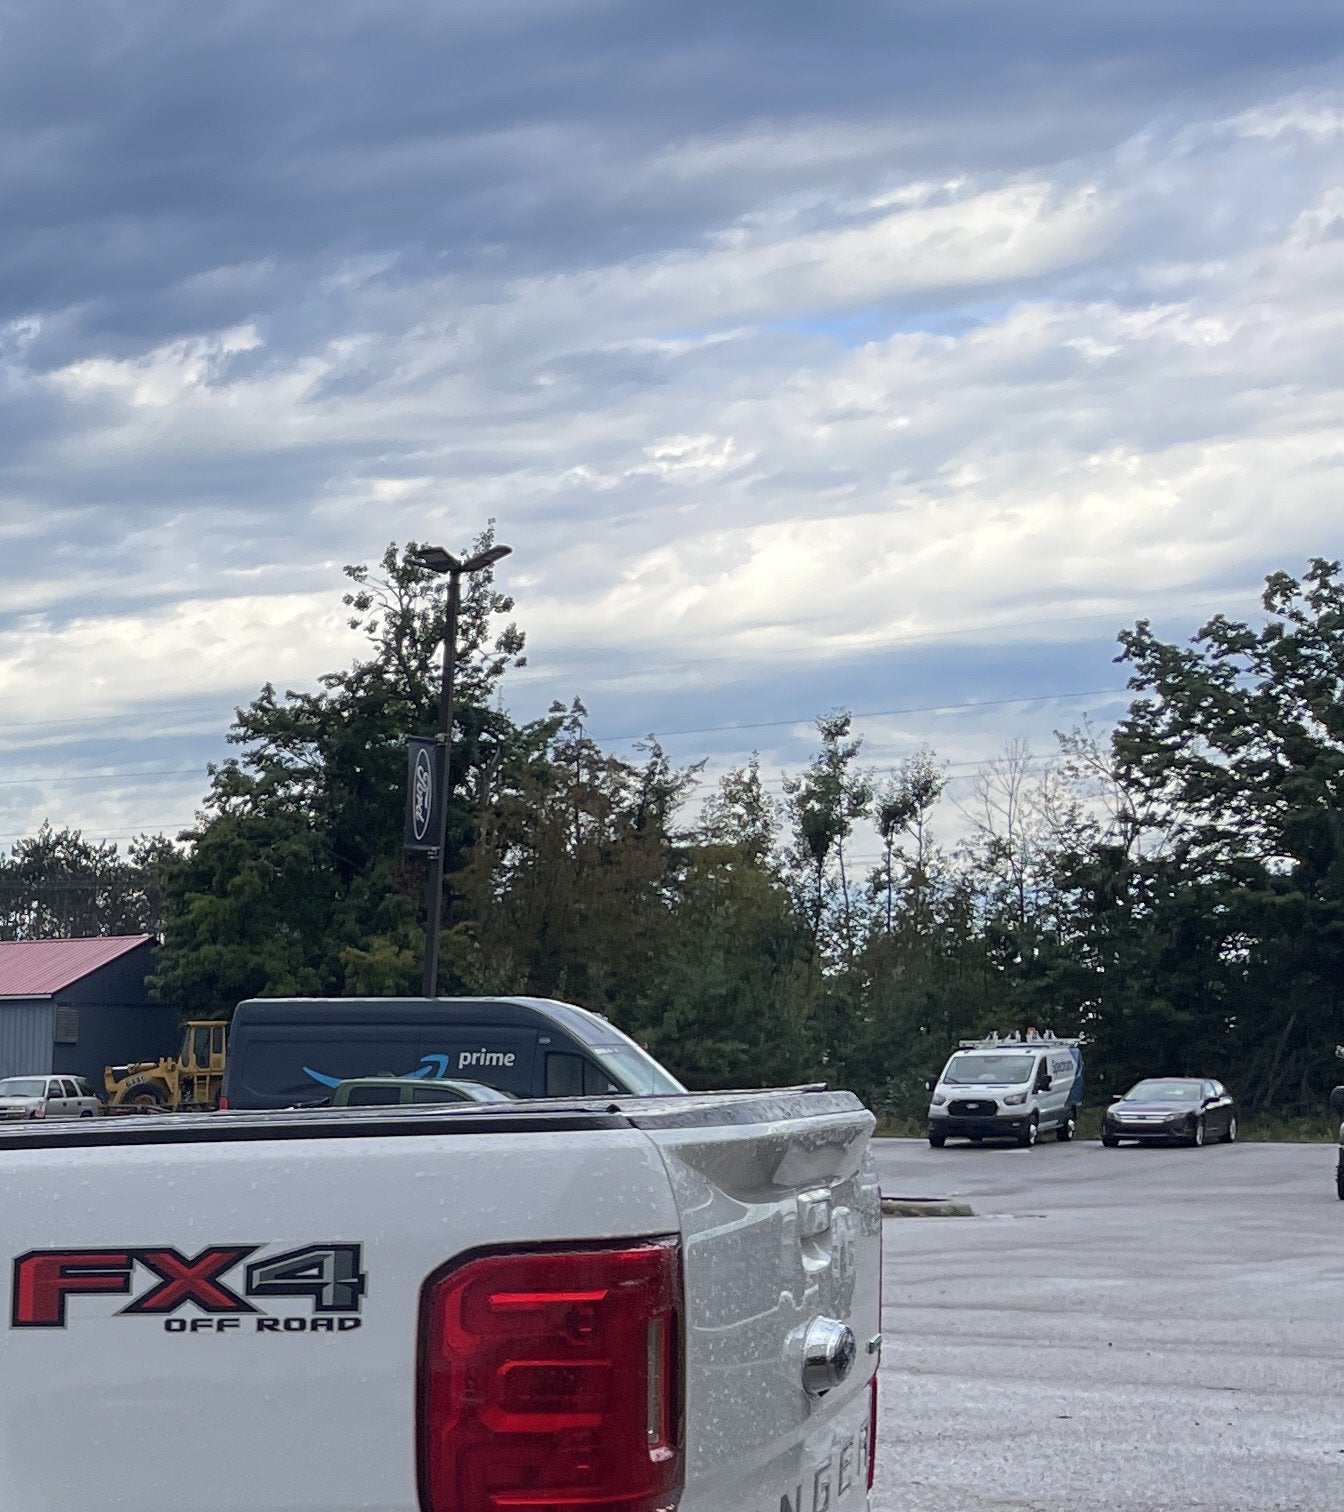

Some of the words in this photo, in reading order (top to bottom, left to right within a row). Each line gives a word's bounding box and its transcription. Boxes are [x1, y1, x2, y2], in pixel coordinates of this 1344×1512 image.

[415, 764, 429, 822] Ford
[458, 1047, 516, 1069] prime
[10, 1241, 367, 1330] FX4
[164, 1317, 241, 1333] OFF
[256, 1317, 362, 1333] ROAD
